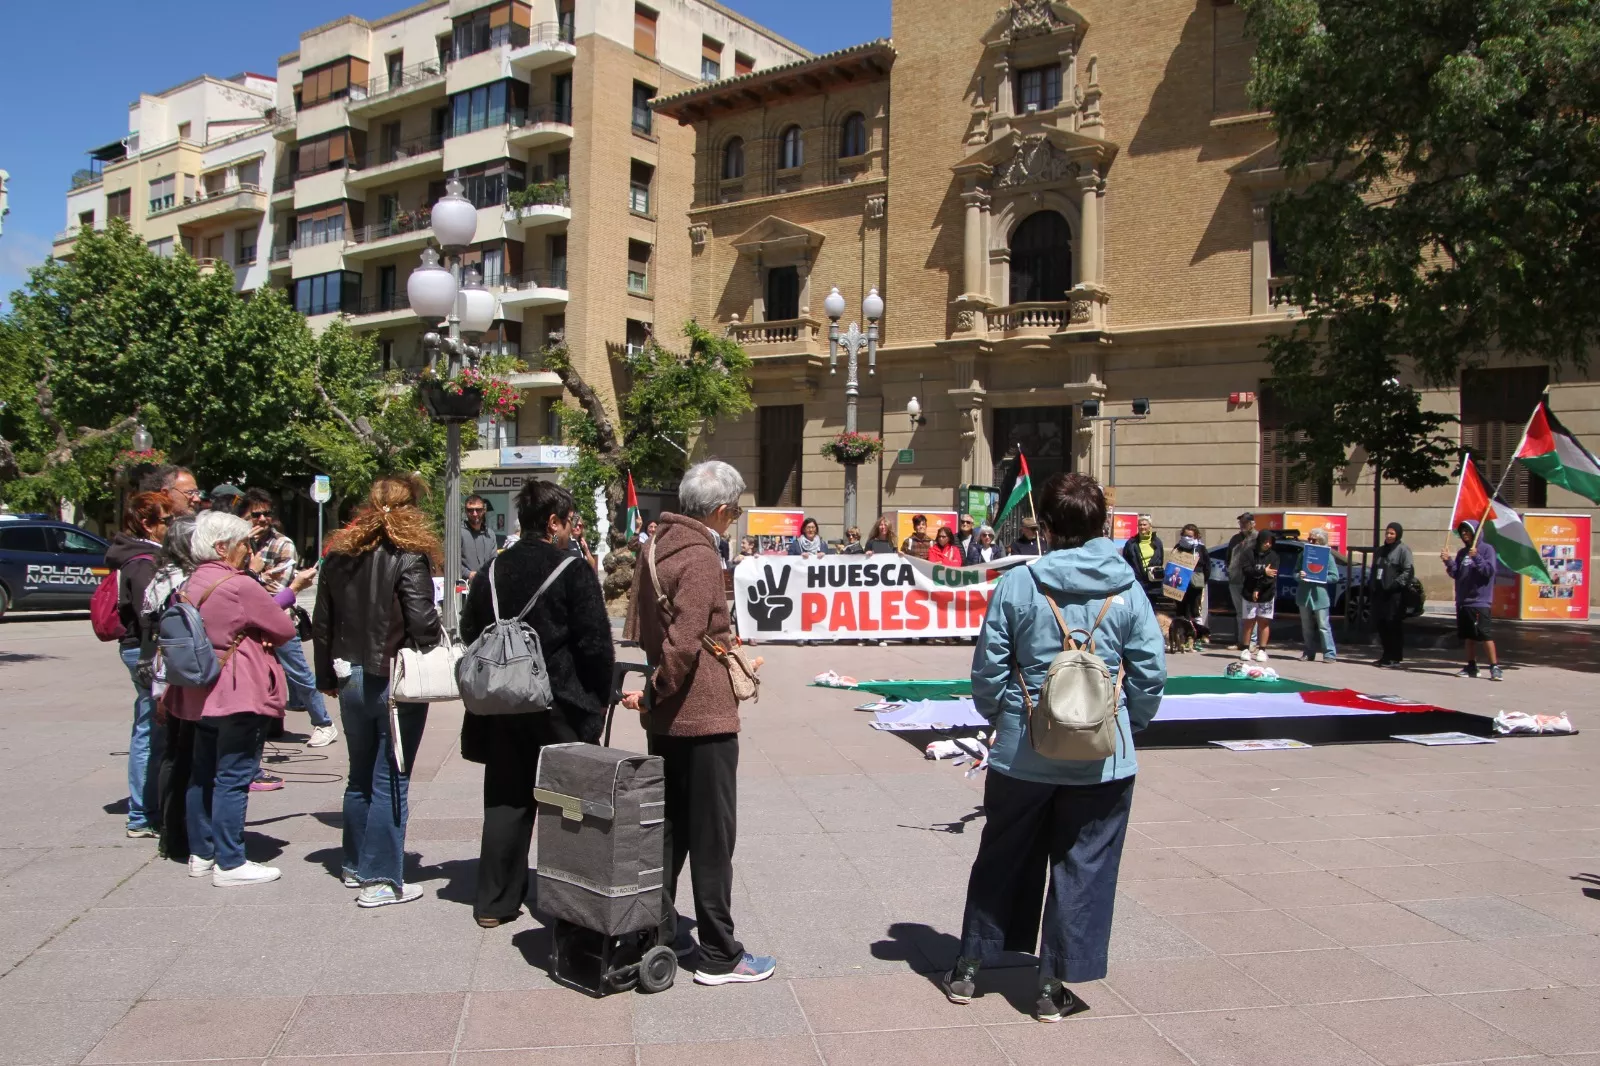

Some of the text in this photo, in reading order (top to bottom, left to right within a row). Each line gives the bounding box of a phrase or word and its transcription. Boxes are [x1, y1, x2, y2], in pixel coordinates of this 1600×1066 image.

[473, 476, 538, 488] VITALDET
[26, 575, 102, 585] NACIONAL
[807, 563, 979, 588] HUESCA CON
[801, 589, 993, 632] PALESTIN
